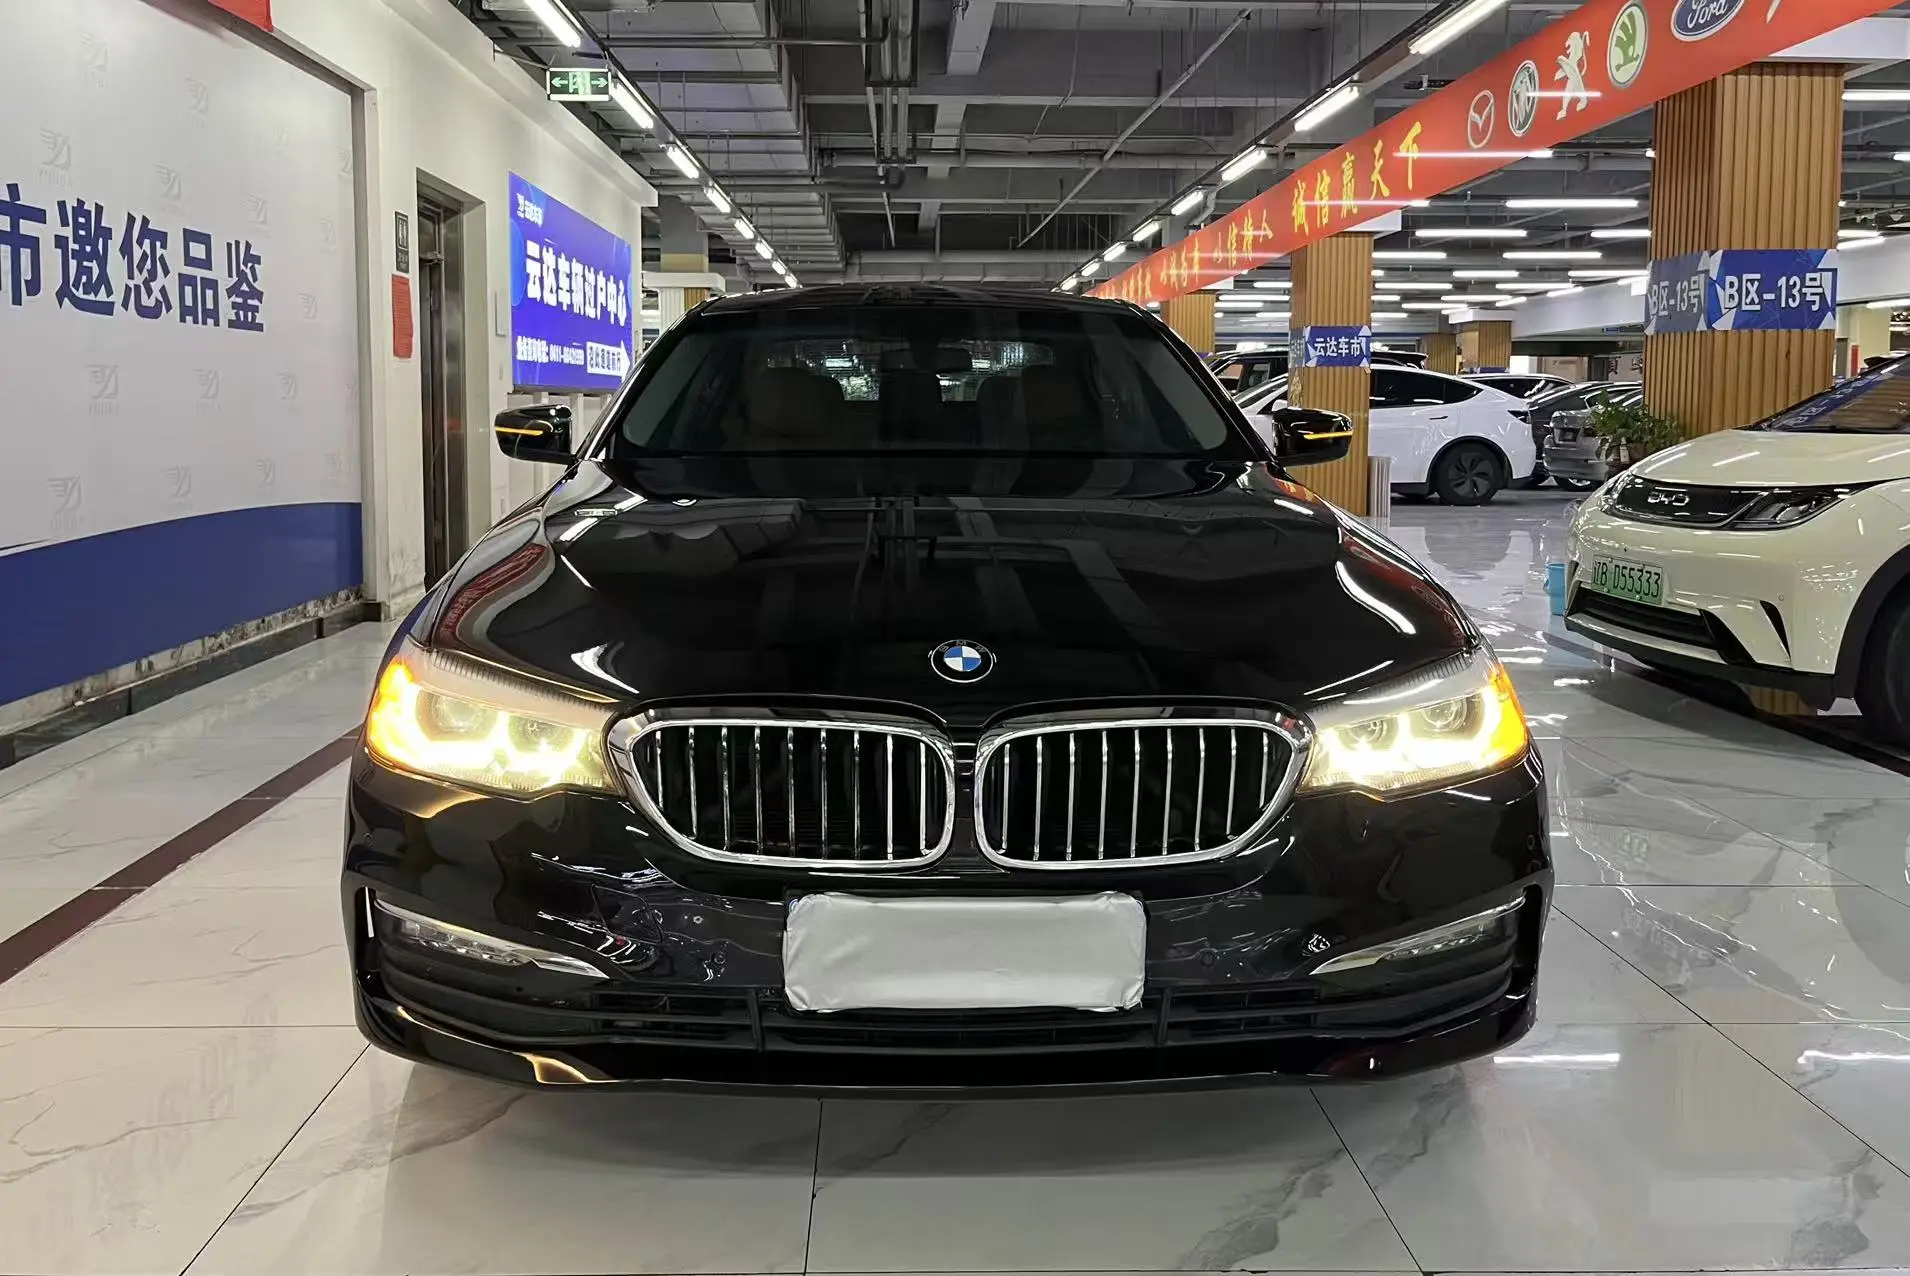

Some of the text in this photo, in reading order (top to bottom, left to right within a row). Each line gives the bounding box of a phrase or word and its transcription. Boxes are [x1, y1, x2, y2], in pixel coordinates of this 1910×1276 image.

[1291, 120, 1422, 236] 诚信赢天下
[0, 183, 264, 333] 市邀您品鉴
[526, 239, 627, 327] 云达车辆过户中心
[1650, 276, 1703, 317] B区-13号
[1724, 272, 1824, 312] B区-13号
[1314, 336, 1361, 357] 云达车市
[1613, 564, 1661, 598] D55333
